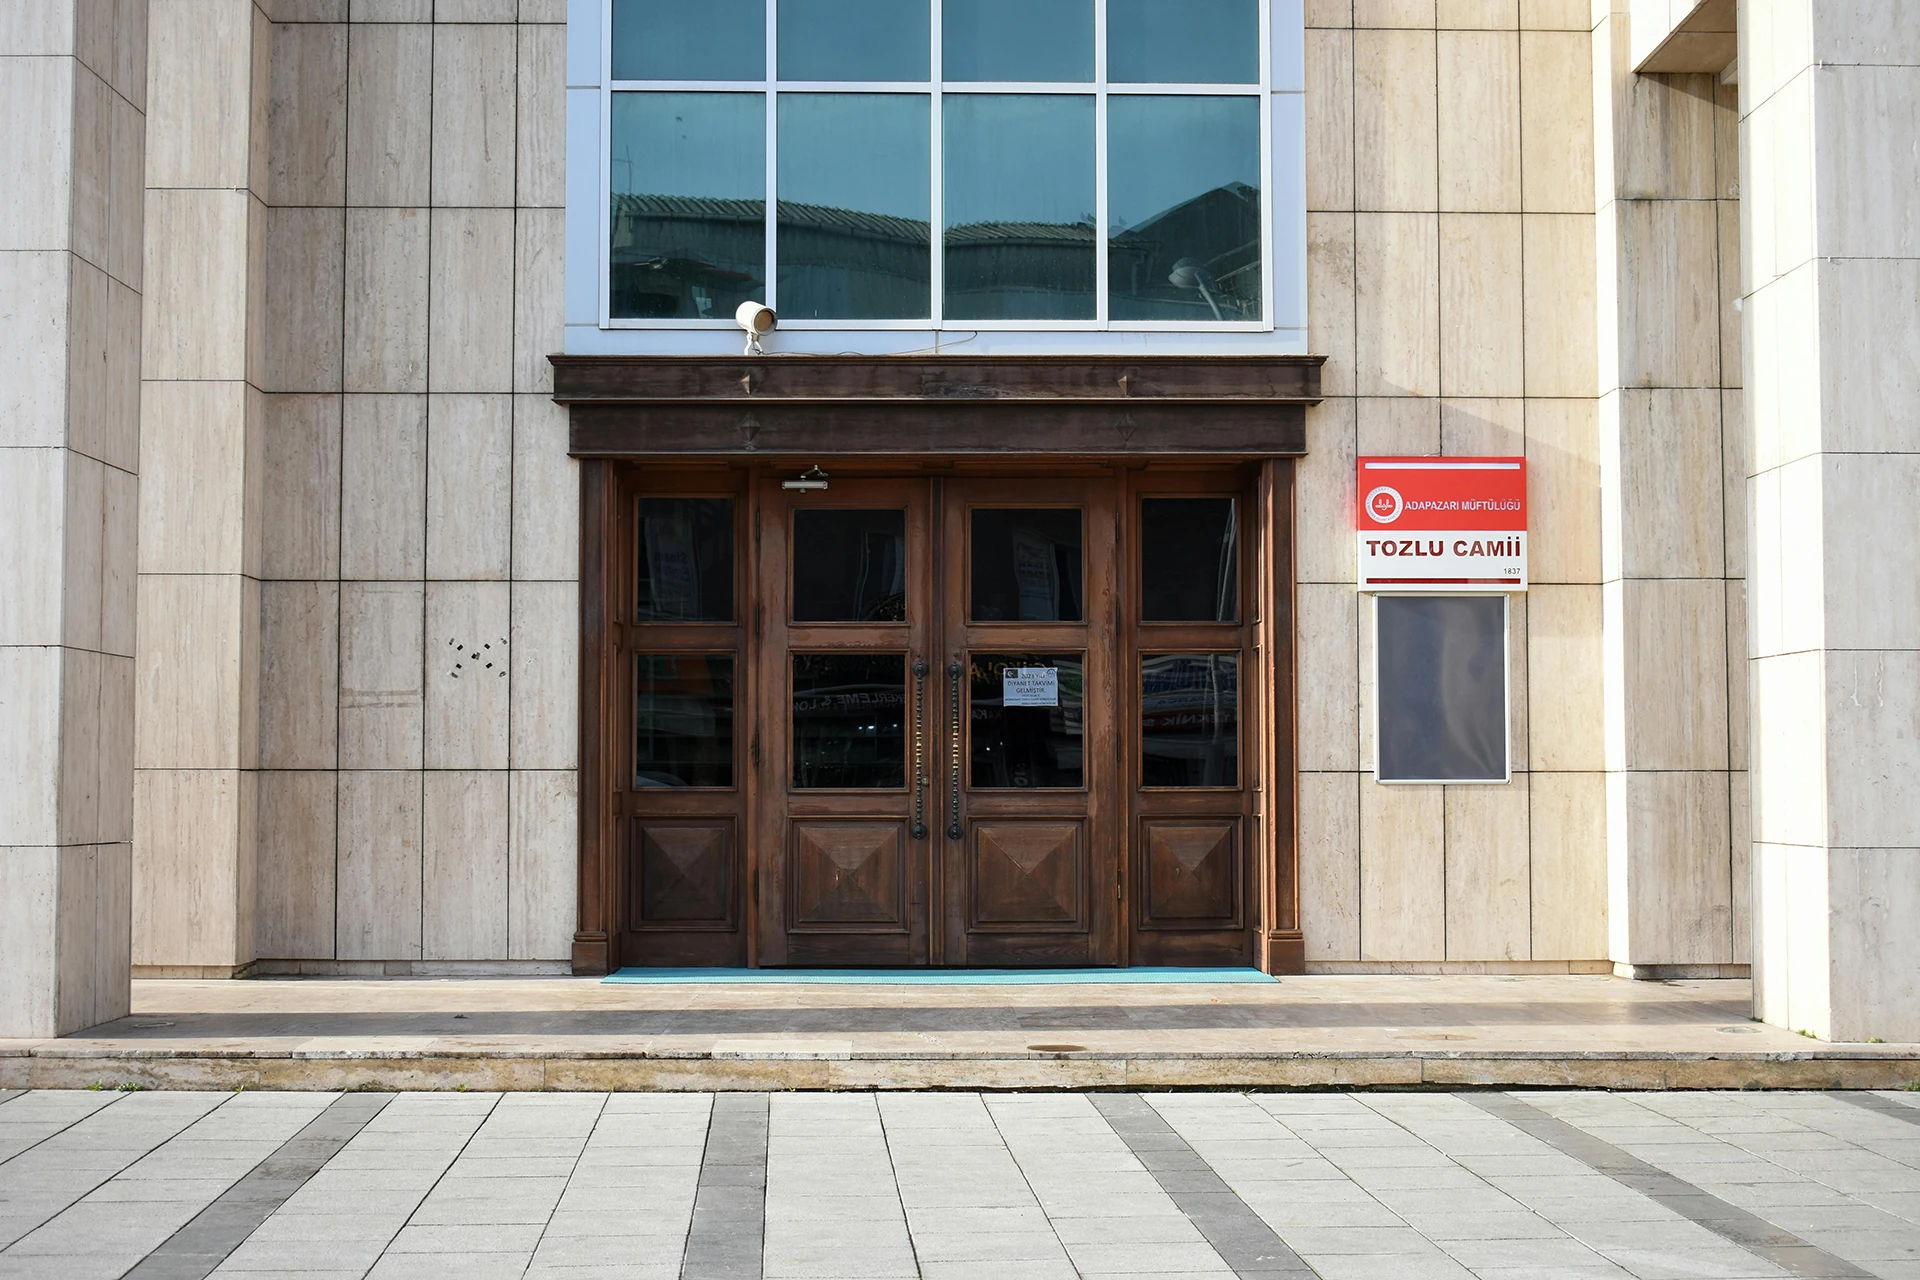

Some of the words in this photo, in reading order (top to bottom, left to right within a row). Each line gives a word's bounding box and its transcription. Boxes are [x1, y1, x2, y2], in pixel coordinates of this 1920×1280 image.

[1405, 500, 1459, 510] ADAPAZARI
[1461, 498, 1521, 511] MÜFTÜLÜĞÜ
[1366, 540, 1444, 557] TOZLU
[1503, 567, 1521, 575] 1837
